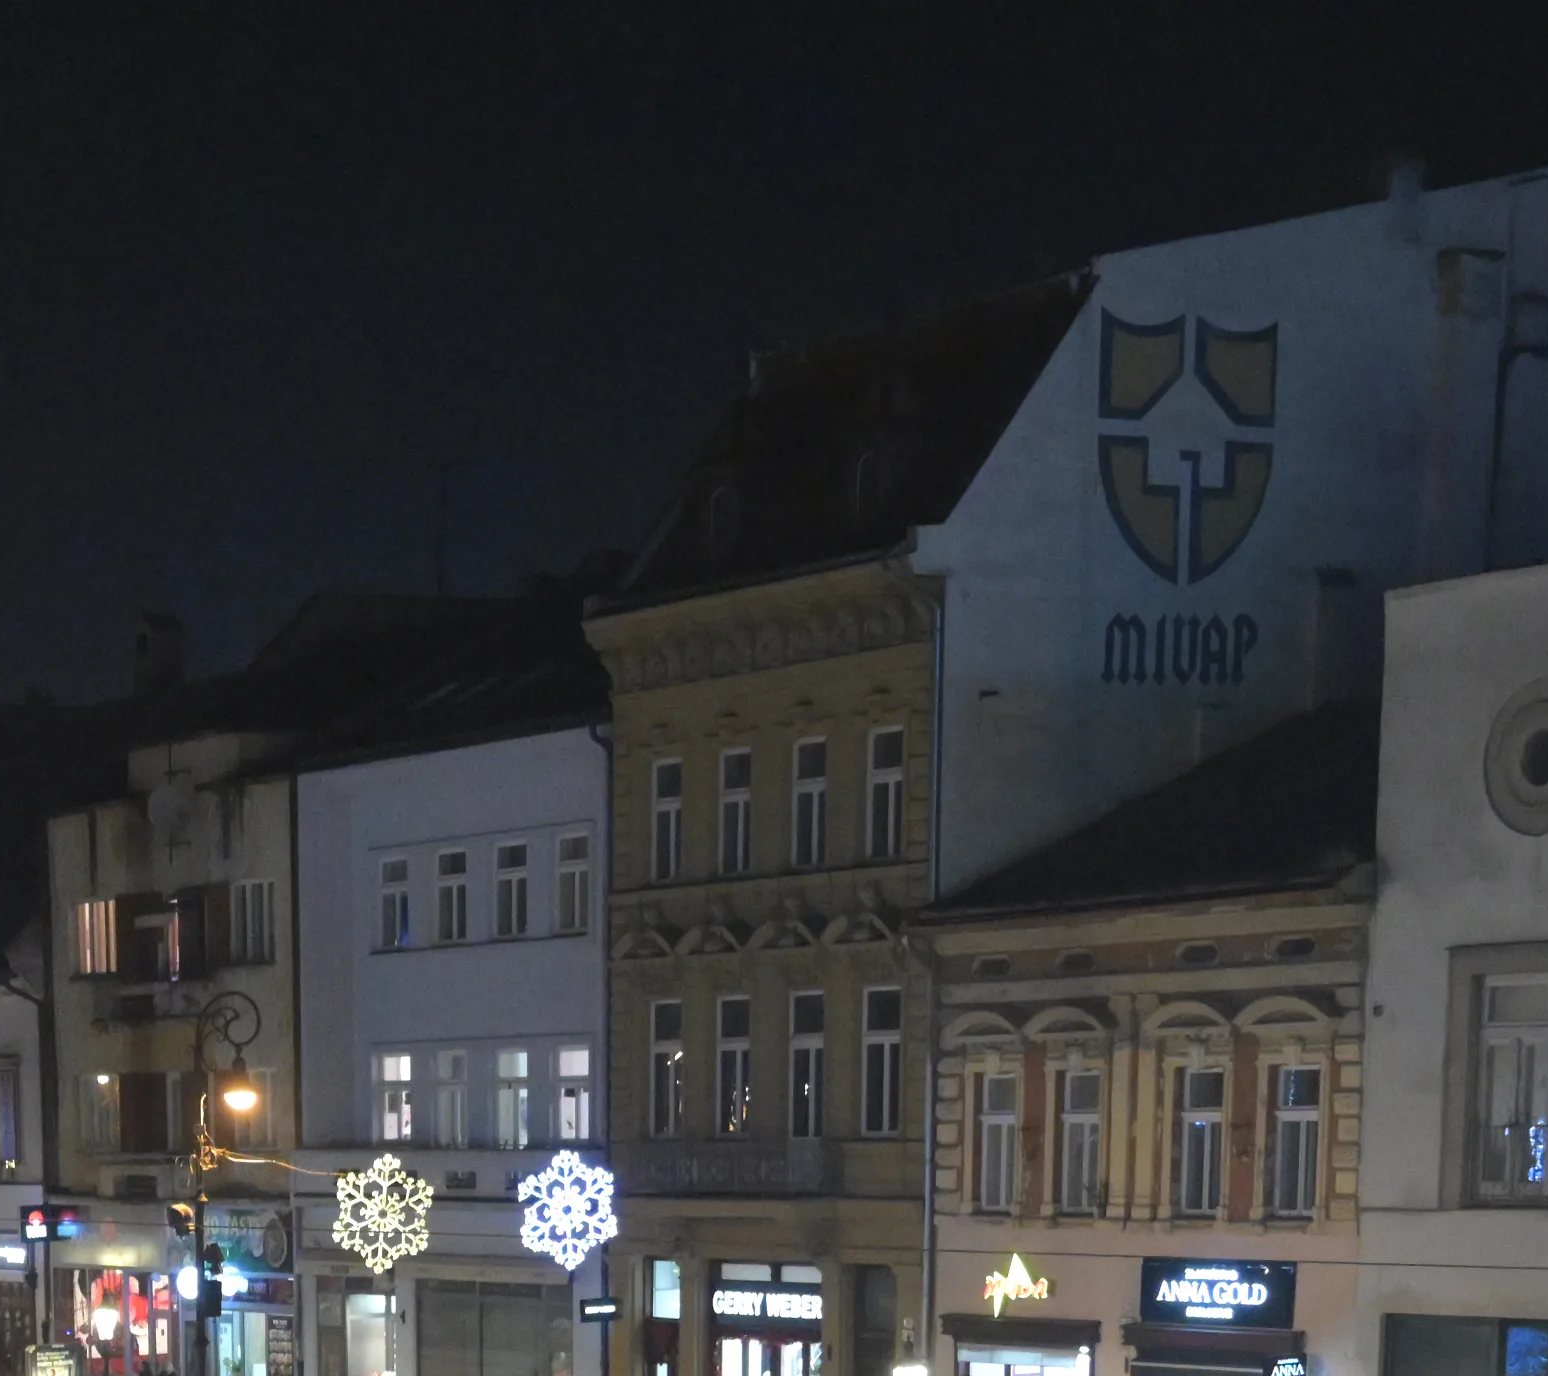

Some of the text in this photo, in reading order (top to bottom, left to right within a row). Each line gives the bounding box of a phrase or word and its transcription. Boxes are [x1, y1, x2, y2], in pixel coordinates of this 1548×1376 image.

[712, 1290, 823, 1320] GERRY WEBER
[1156, 1279, 1267, 1306] ANNA GOLD
